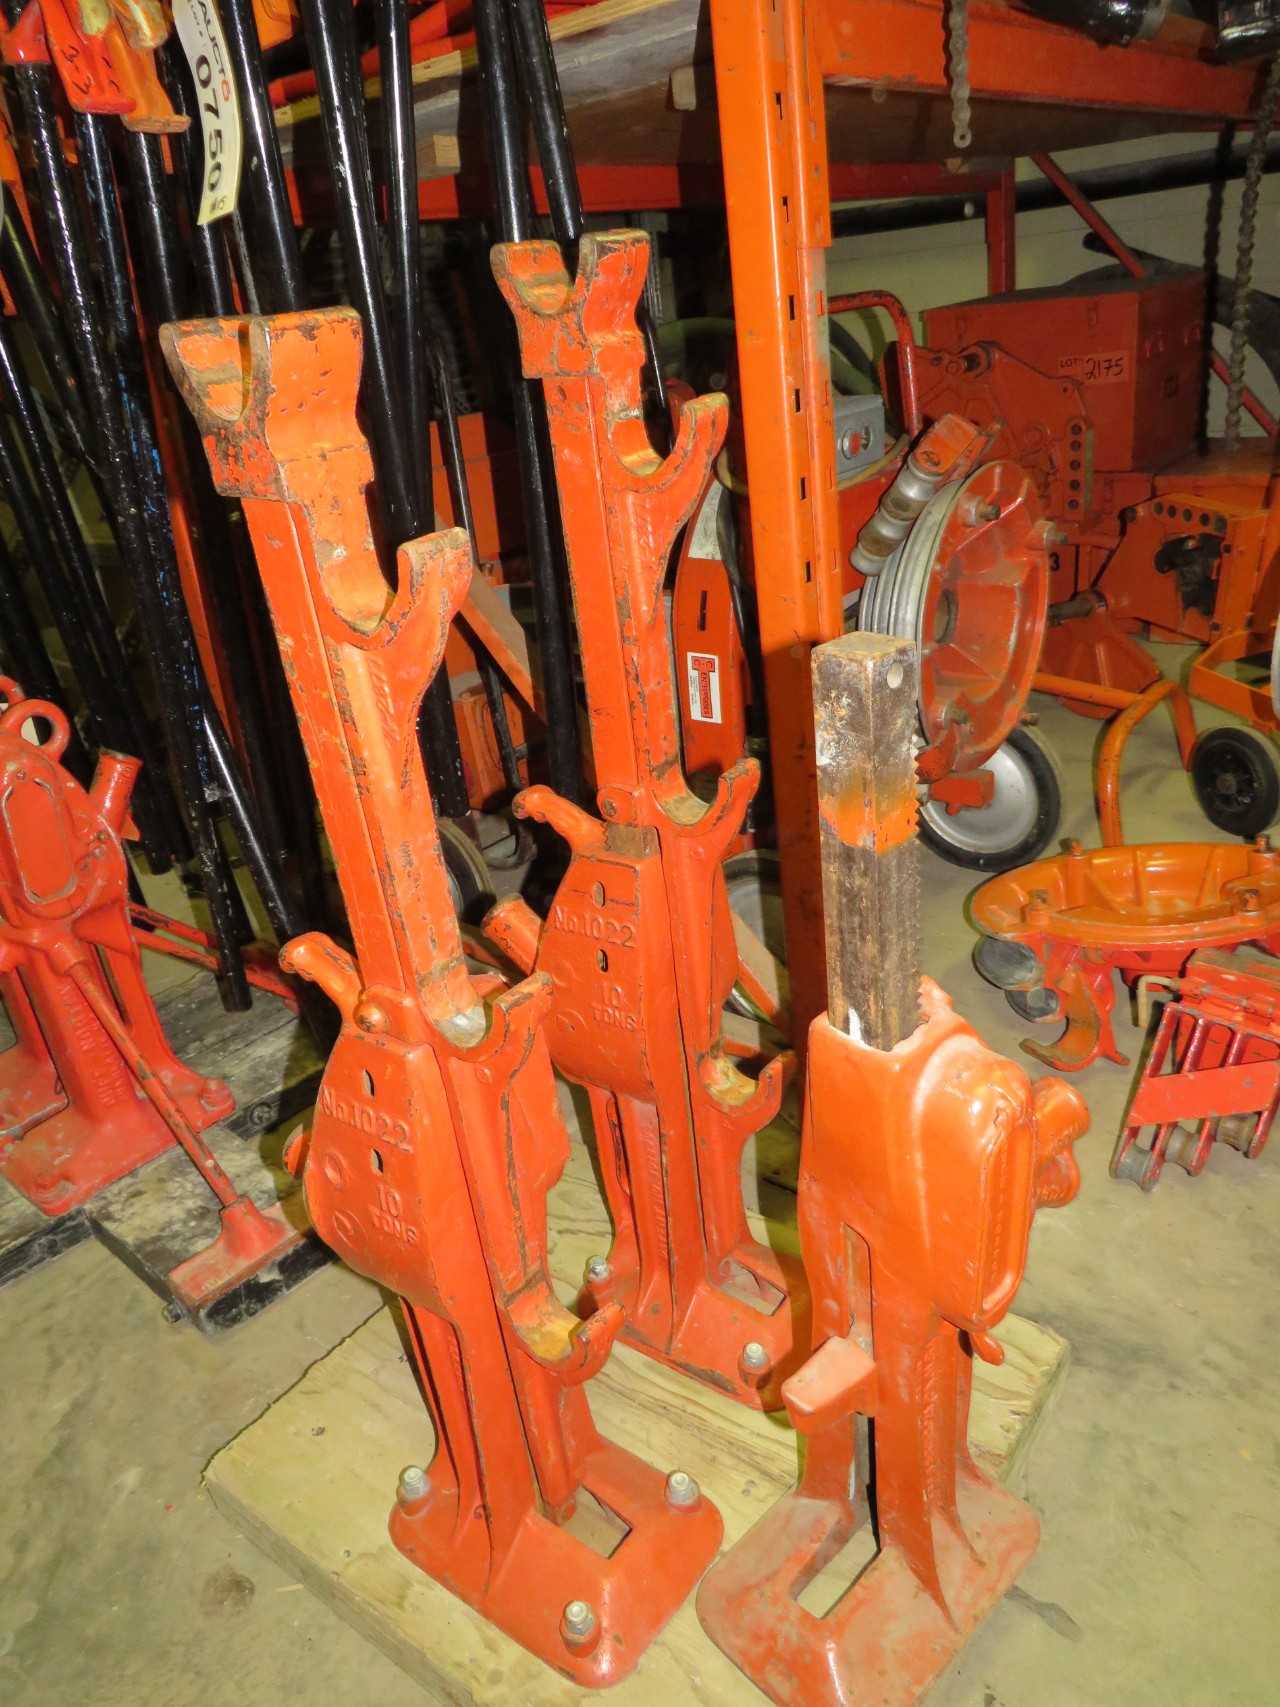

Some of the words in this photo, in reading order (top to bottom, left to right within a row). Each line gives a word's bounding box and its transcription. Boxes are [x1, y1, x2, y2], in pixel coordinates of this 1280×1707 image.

[1085, 356, 1124, 380] 2175
[602, 981, 625, 1008] 10
[592, 1001, 636, 1030] TONS
[376, 1184, 401, 1218] 10
[369, 1205, 417, 1239] TONS
